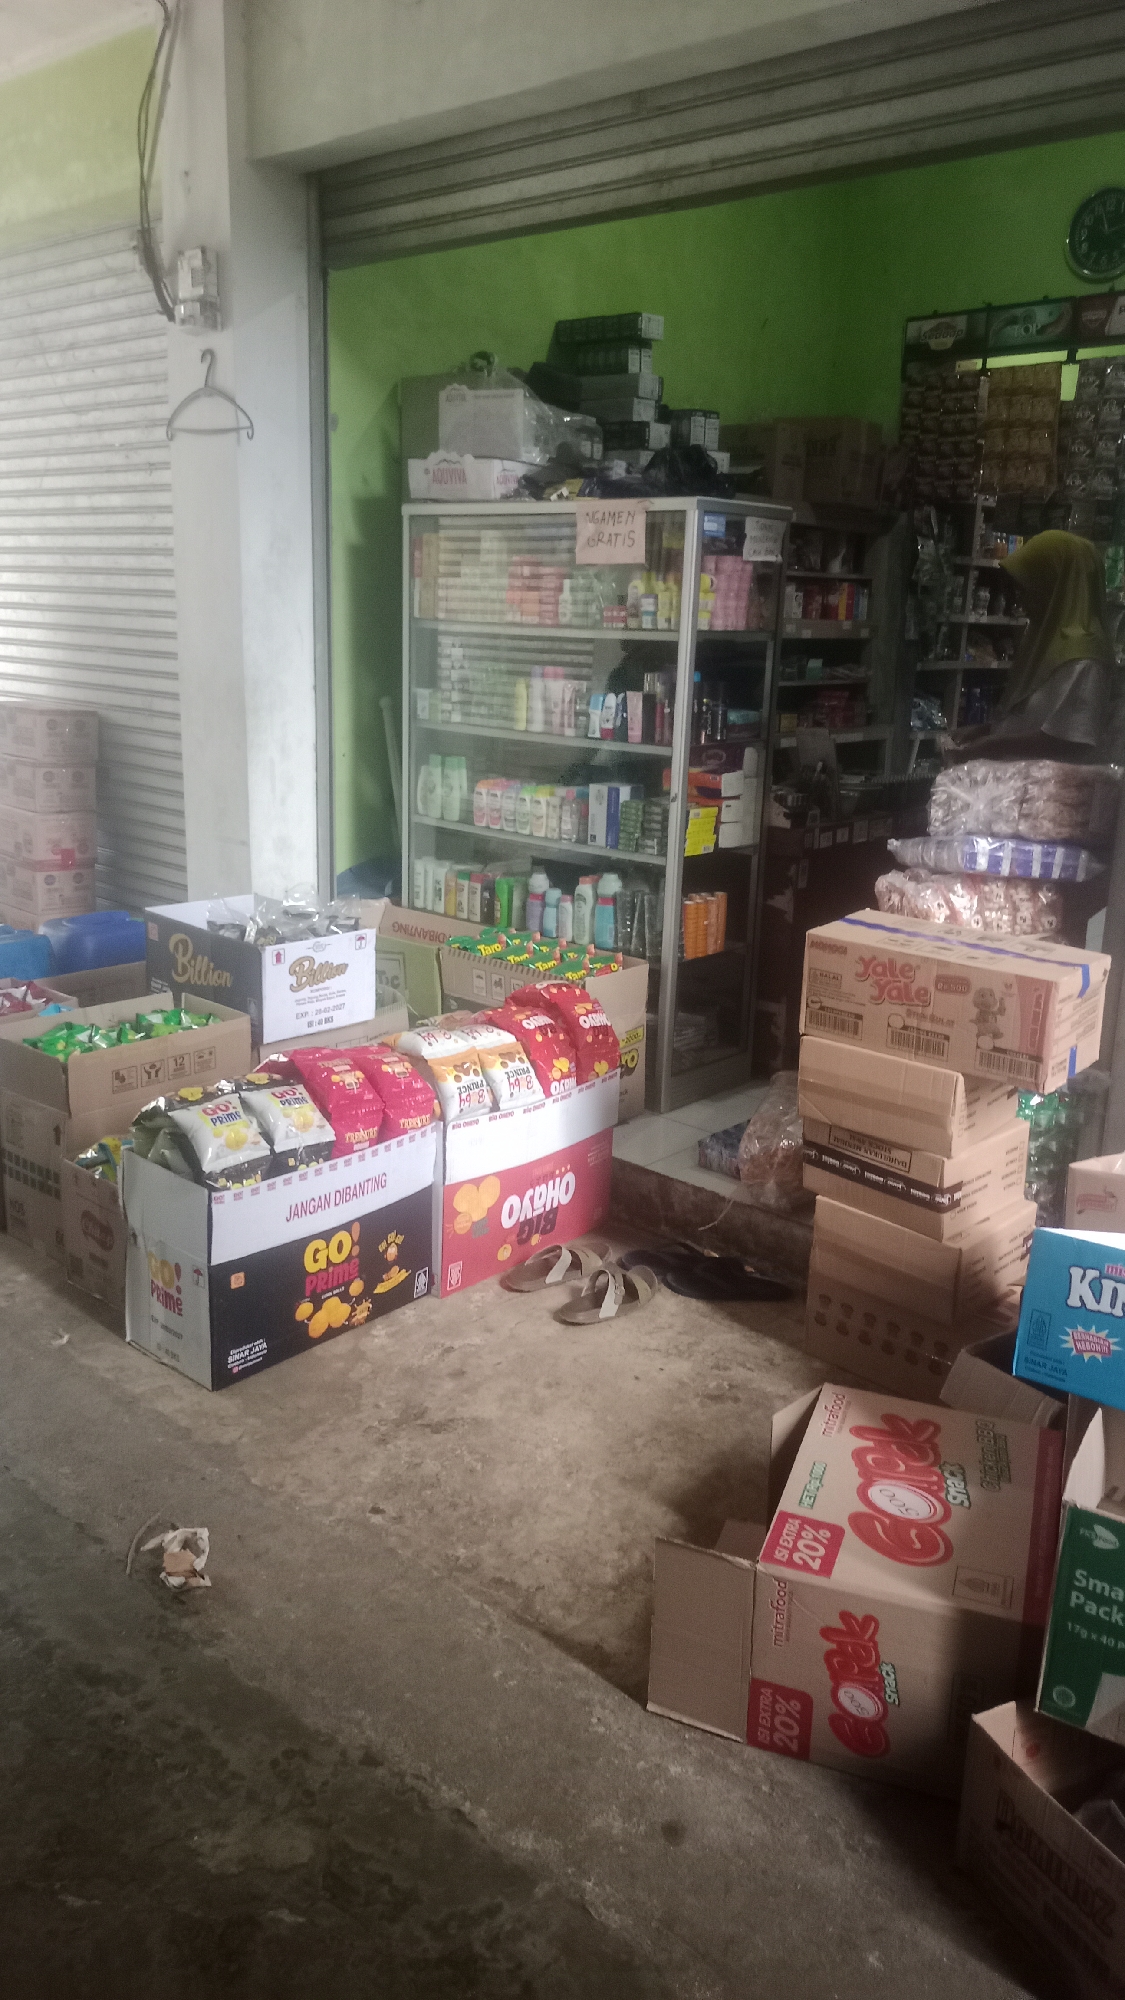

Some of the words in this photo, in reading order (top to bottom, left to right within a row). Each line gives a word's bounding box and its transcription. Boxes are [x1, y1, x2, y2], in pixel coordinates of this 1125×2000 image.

[587, 530, 636, 548] GRATIS
[168, 933, 233, 988] Billion
[288, 955, 349, 993] Billion
[854, 955, 921, 984] Yale
[869, 979, 932, 1008] Yale
[457, 1079, 485, 1095] PRINCE
[504, 1066, 531, 1081] PRINCE
[286, 1193, 332, 1223] JANGAN
[333, 1172, 388, 1208] DIBANTING
[303, 1221, 361, 1274] GO!
[821, 1392, 847, 1438] mitrafood
[793, 1523, 832, 1572] 20%
[769, 1576, 790, 1648] mitrafood
[772, 1693, 804, 1753] 20%
